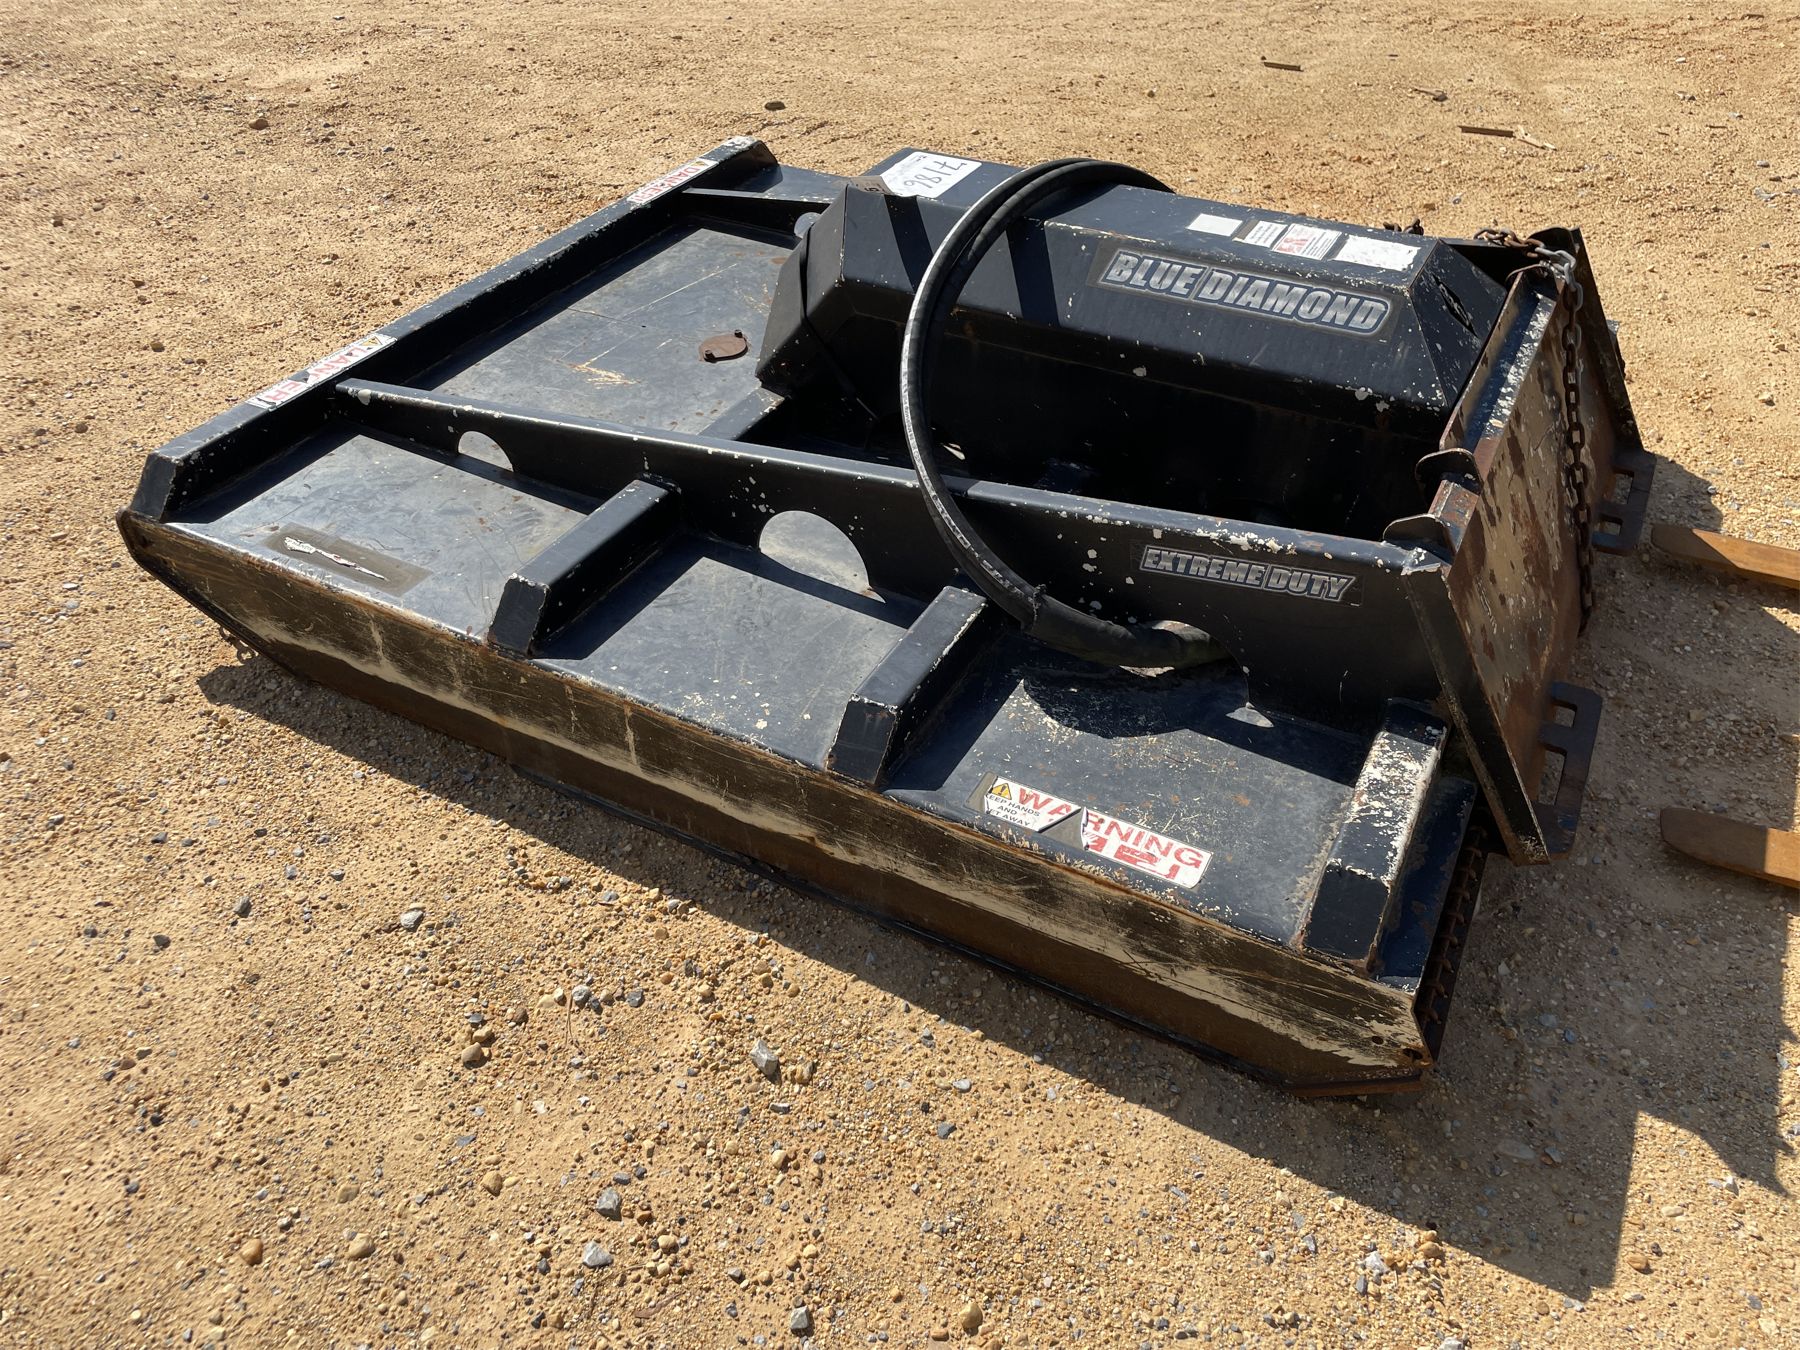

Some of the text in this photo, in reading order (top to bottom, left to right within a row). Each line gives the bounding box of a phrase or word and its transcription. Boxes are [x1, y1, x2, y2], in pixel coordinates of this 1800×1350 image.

[903, 160, 967, 189] 7186
[1105, 251, 1389, 331] BLUE DIAMOND
[1143, 548, 1348, 598] EXTREME DUTY
[987, 793, 1041, 817] EEP HANDS
[997, 805, 1018, 816] AND
[1002, 814, 1031, 827] AWAY
